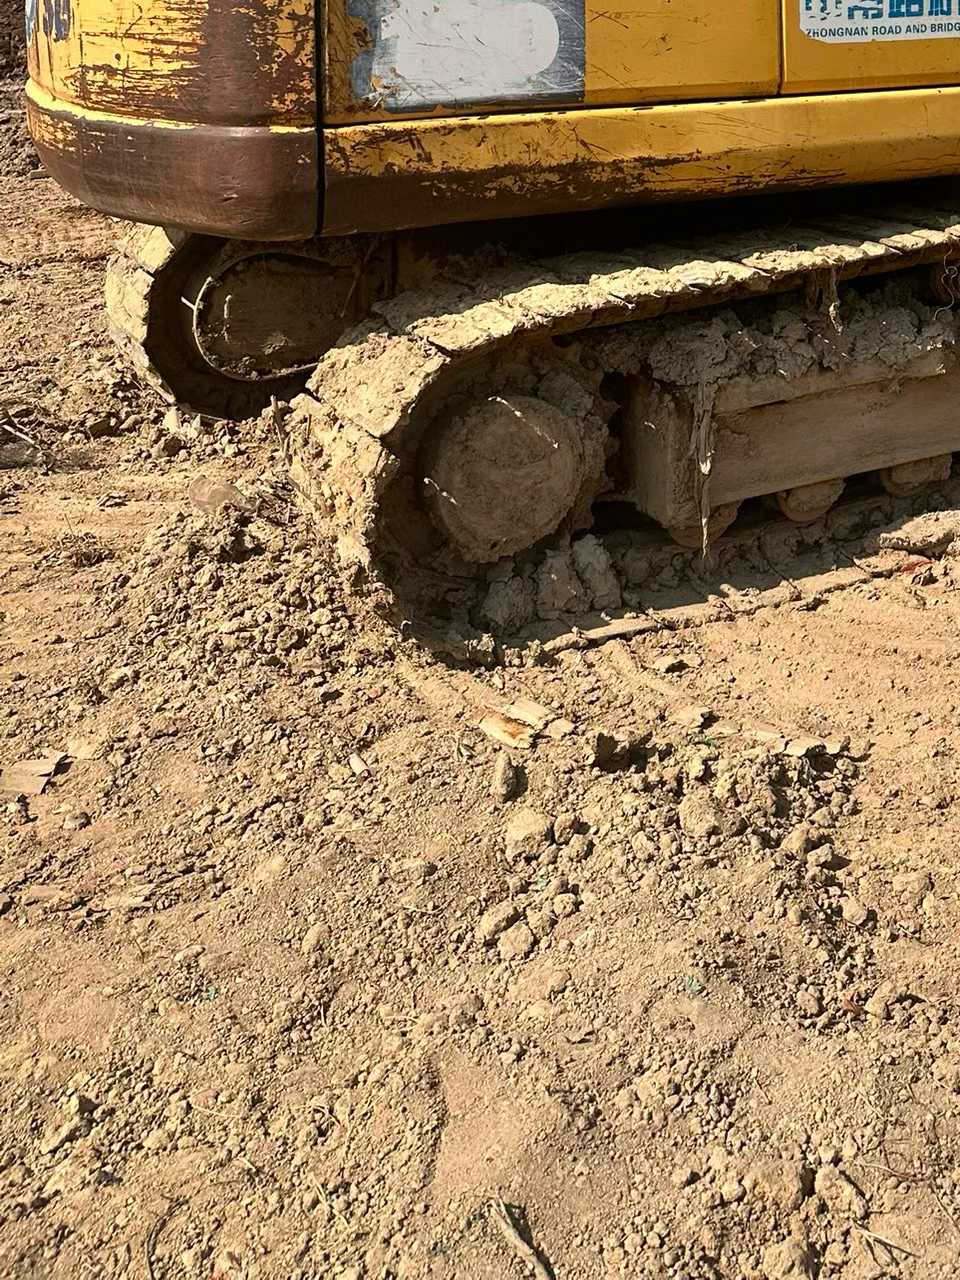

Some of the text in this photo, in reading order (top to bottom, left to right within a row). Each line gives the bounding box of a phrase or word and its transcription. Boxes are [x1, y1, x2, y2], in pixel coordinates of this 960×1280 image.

[806, 25, 868, 38] ZHONGNAN
[872, 24, 902, 36] ROAD
[905, 23, 927, 34] AND
